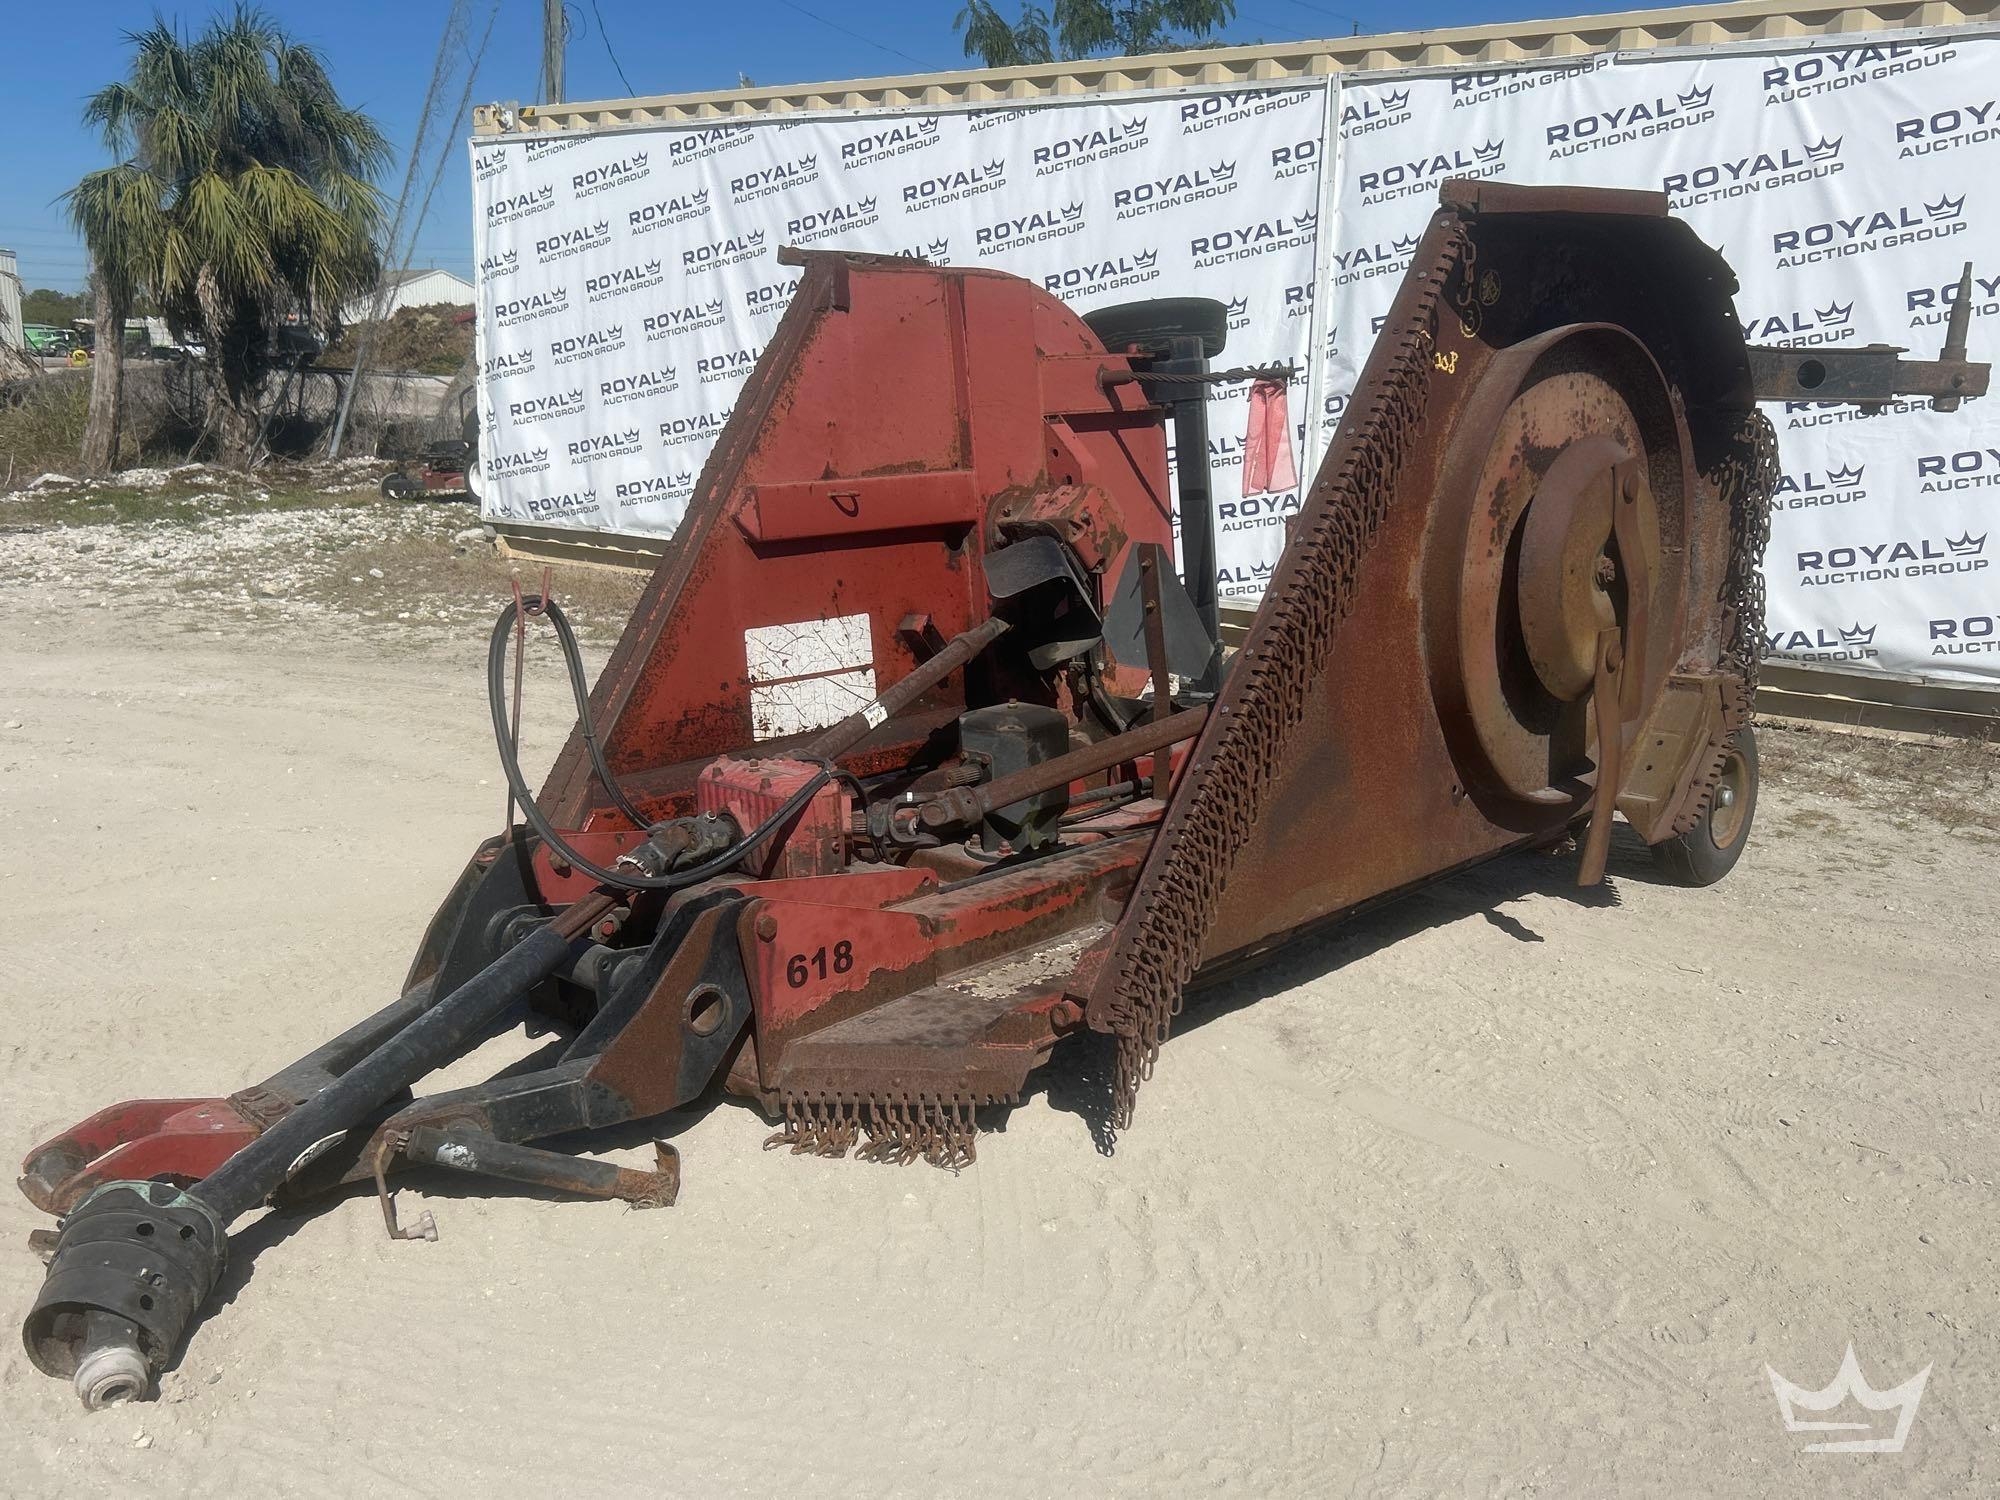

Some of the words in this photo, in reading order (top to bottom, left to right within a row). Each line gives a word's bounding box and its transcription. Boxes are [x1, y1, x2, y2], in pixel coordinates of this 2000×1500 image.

[1763, 41, 1912, 91] ROYAL
[1766, 72, 1866, 106] AUCTION
[1872, 50, 1956, 80] GROUP
[1454, 78, 1534, 109] AUCTION
[1540, 59, 1609, 86] GROUP
[1181, 88, 1282, 122] ROYAL
[1183, 108, 1250, 135] AUCTION
[1254, 92, 1310, 115] GROUP
[969, 110, 1026, 133] AUCTION
[1352, 112, 1412, 137] GROUP
[1546, 98, 1676, 146] ROYAL
[1549, 130, 1636, 160] AUCTION
[1642, 110, 1714, 137] GROUP
[1896, 100, 2000, 143] ROY
[527, 144, 566, 163] AUCTION
[568, 136, 600, 148] GROU
[670, 124, 735, 156] ROYAL
[672, 146, 716, 167] AUCTION
[718, 134, 754, 152] GROUP
[842, 125, 918, 160] ROYAL
[844, 148, 895, 171] AUCTION
[898, 135, 940, 154] GROUP
[1034, 126, 1122, 164] ROYAL
[1036, 152, 1096, 177] AUCTION
[1099, 138, 1148, 159] GROUP
[1274, 162, 1317, 180] AUCT
[480, 164, 508, 180] GROUP
[573, 160, 632, 190] ROYAL
[576, 180, 615, 200] AUCTION
[617, 168, 650, 186] GROUP
[731, 162, 799, 194] ROYAL
[903, 168, 983, 202] ROYAL
[1360, 150, 1472, 193] ROYAL
[1664, 149, 1803, 196] ROYAL
[734, 184, 780, 205] AUCTION
[779, 172, 818, 190] GROUP
[906, 192, 959, 214] AUCTION
[962, 179, 1006, 198] GROUP
[1114, 170, 1209, 208] ROYAL
[1362, 179, 1438, 206] AUCTION
[1668, 181, 1760, 210] AUCTION
[1765, 162, 1844, 189] GROUP
[487, 192, 539, 219] ROYAL
[524, 200, 555, 216] GROUP
[629, 196, 692, 226] ROYAL
[1117, 196, 1181, 220] AUCTION
[1184, 182, 1237, 203] GROUP
[632, 217, 674, 236] AUCTION
[676, 206, 710, 222] GROUP
[788, 204, 858, 236] ROYAL
[791, 226, 838, 246] AUCTION
[840, 215, 878, 232] GROUP
[976, 210, 1060, 245] ROYAL
[1774, 207, 1923, 254] ROYAL
[536, 227, 594, 254] ROYAL
[539, 247, 578, 264] AUCTION
[579, 236, 611, 252] GROUP
[979, 235, 1035, 257] AUCTION
[1038, 222, 1085, 241] GROUP
[1191, 219, 1293, 256] ROYAL
[1776, 240, 1877, 269] AUCTION
[1882, 222, 1967, 248] GROUP
[481, 256, 503, 274] YAL
[682, 237, 748, 266] ROYAL
[686, 258, 730, 276] AUCTION
[732, 247, 767, 263] GROUP
[1194, 245, 1262, 269] AUCTION
[1333, 244, 1391, 270] YAL
[491, 265, 519, 279] GROUP
[586, 266, 646, 293] ROYAL
[1045, 258, 1133, 292] ROYAL
[1364, 260, 1410, 278] GROU
[589, 286, 628, 303] AUCTION
[630, 276, 663, 291] GROUP
[746, 280, 800, 306] ROYA
[1054, 282, 1107, 300] UCTION
[1110, 270, 1160, 289] GROUP
[1907, 276, 2000, 312] ROY
[495, 292, 552, 318] ROYAL
[498, 312, 537, 328] AUCTION
[538, 303, 569, 317] GROUP
[643, 305, 706, 332] ROYAL
[1909, 302, 2000, 328] AUCIO
[647, 324, 688, 342] AUCTION
[690, 316, 725, 330] GROUP
[1742, 312, 1814, 340] YAL
[551, 331, 608, 356] ROYAL
[554, 350, 594, 365] AUCTION
[594, 342, 625, 355] GROUP
[485, 354, 518, 374] YAL
[503, 365, 536, 378] GROUP
[697, 348, 761, 374] ROYAL
[600, 372, 662, 396] ROYAL
[700, 370, 744, 384] AUCTION
[510, 393, 568, 416] ROYAL
[604, 391, 645, 406] AUCTION
[646, 383, 679, 396] GROUP
[1208, 387, 1251, 402] AUCT
[1894, 396, 1977, 414] GRP
[513, 412, 553, 426] AUCTION
[555, 404, 585, 417] GROUP
[660, 413, 721, 437] ROYAL
[568, 434, 624, 456] ROYAL
[663, 432, 704, 447] AUCTION
[705, 428, 724, 438] GRO
[571, 452, 607, 465] AUCTION
[609, 445, 642, 457] GROUP
[1211, 456, 1242, 468] GRO
[1918, 448, 2000, 478] ROY
[519, 463, 550, 475] GROUP
[616, 475, 676, 498] ROYAL
[1920, 474, 2000, 493] AUCTI
[528, 492, 584, 512] ROYAL
[570, 504, 600, 516] GROUP
[620, 494, 660, 507] AUCTION
[661, 488, 693, 501] GROUP
[1219, 494, 1300, 519] ROYA
[1789, 490, 1866, 509] GROUP
[1222, 516, 1287, 532] AUCTION
[1798, 540, 1944, 571] ROYAL
[1800, 568, 1899, 586] AUCTION
[1905, 560, 1988, 576] GROUP
[1226, 584, 1268, 596] GROU
[1765, 630, 1838, 650] YAL
[1932, 640, 2000, 655] AUCT
[1802, 649, 1878, 662] GROUP
[787, 940, 853, 988] 618
